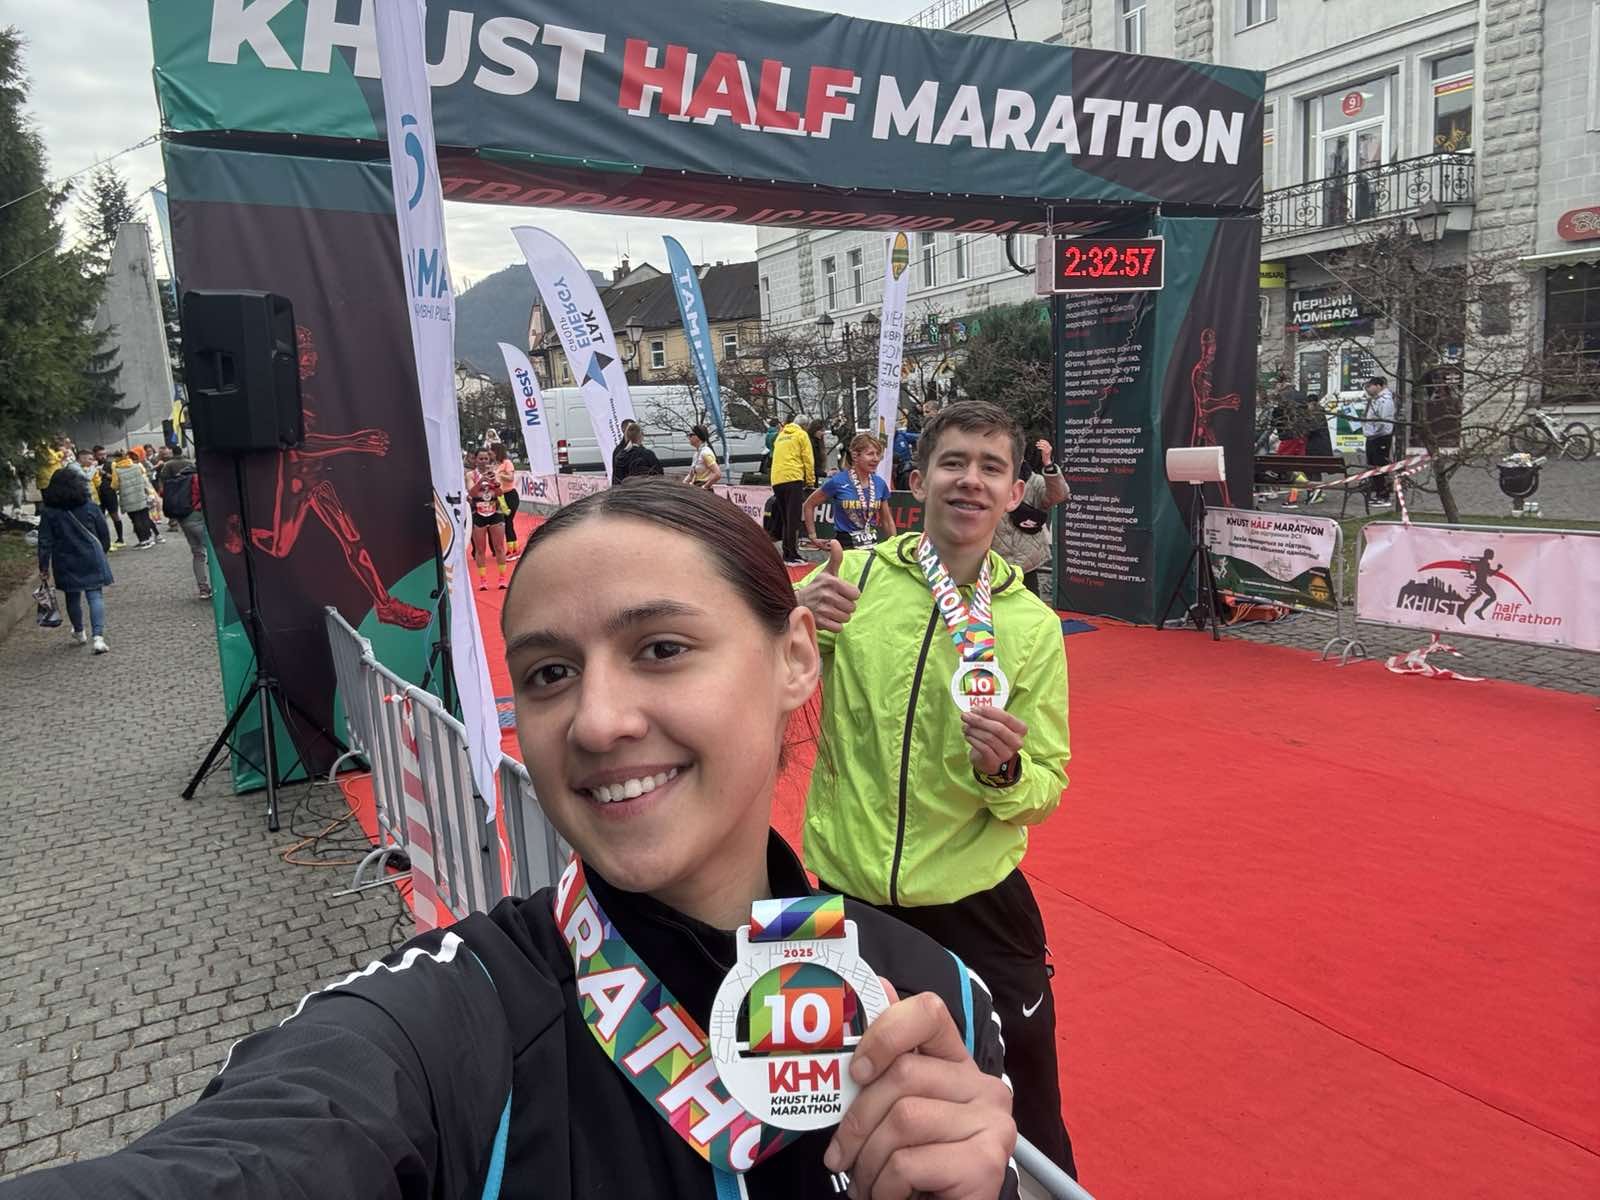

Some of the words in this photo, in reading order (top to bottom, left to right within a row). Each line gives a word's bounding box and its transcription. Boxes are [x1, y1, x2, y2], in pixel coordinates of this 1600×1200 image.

[618, 38, 861, 138] HALF
[872, 75, 1244, 165] MARATHON
[1064, 246, 1156, 277] 2:32:57
[1293, 294, 1352, 312] ПЕРШИЙ
[1293, 308, 1359, 323] ЛОМБАРД
[516, 368, 541, 426] Meest
[521, 476, 548, 498] Meest
[733, 493, 748, 504] TAK
[1251, 519, 1273, 531] HALF
[1273, 521, 1324, 537] MARATHON
[1401, 594, 1465, 616] KHUST
[1494, 601, 1523, 613] half
[1491, 612, 1562, 626] marathon
[970, 677, 991, 693] 10
[969, 697, 992, 708] KHM
[783, 948, 813, 959] 2025
[764, 992, 831, 1045] 10
[768, 1058, 841, 1093] KHM
[770, 1095, 809, 1105] KHUST
[810, 1093, 840, 1104] HALF
[770, 1103, 842, 1116] MARATHON
